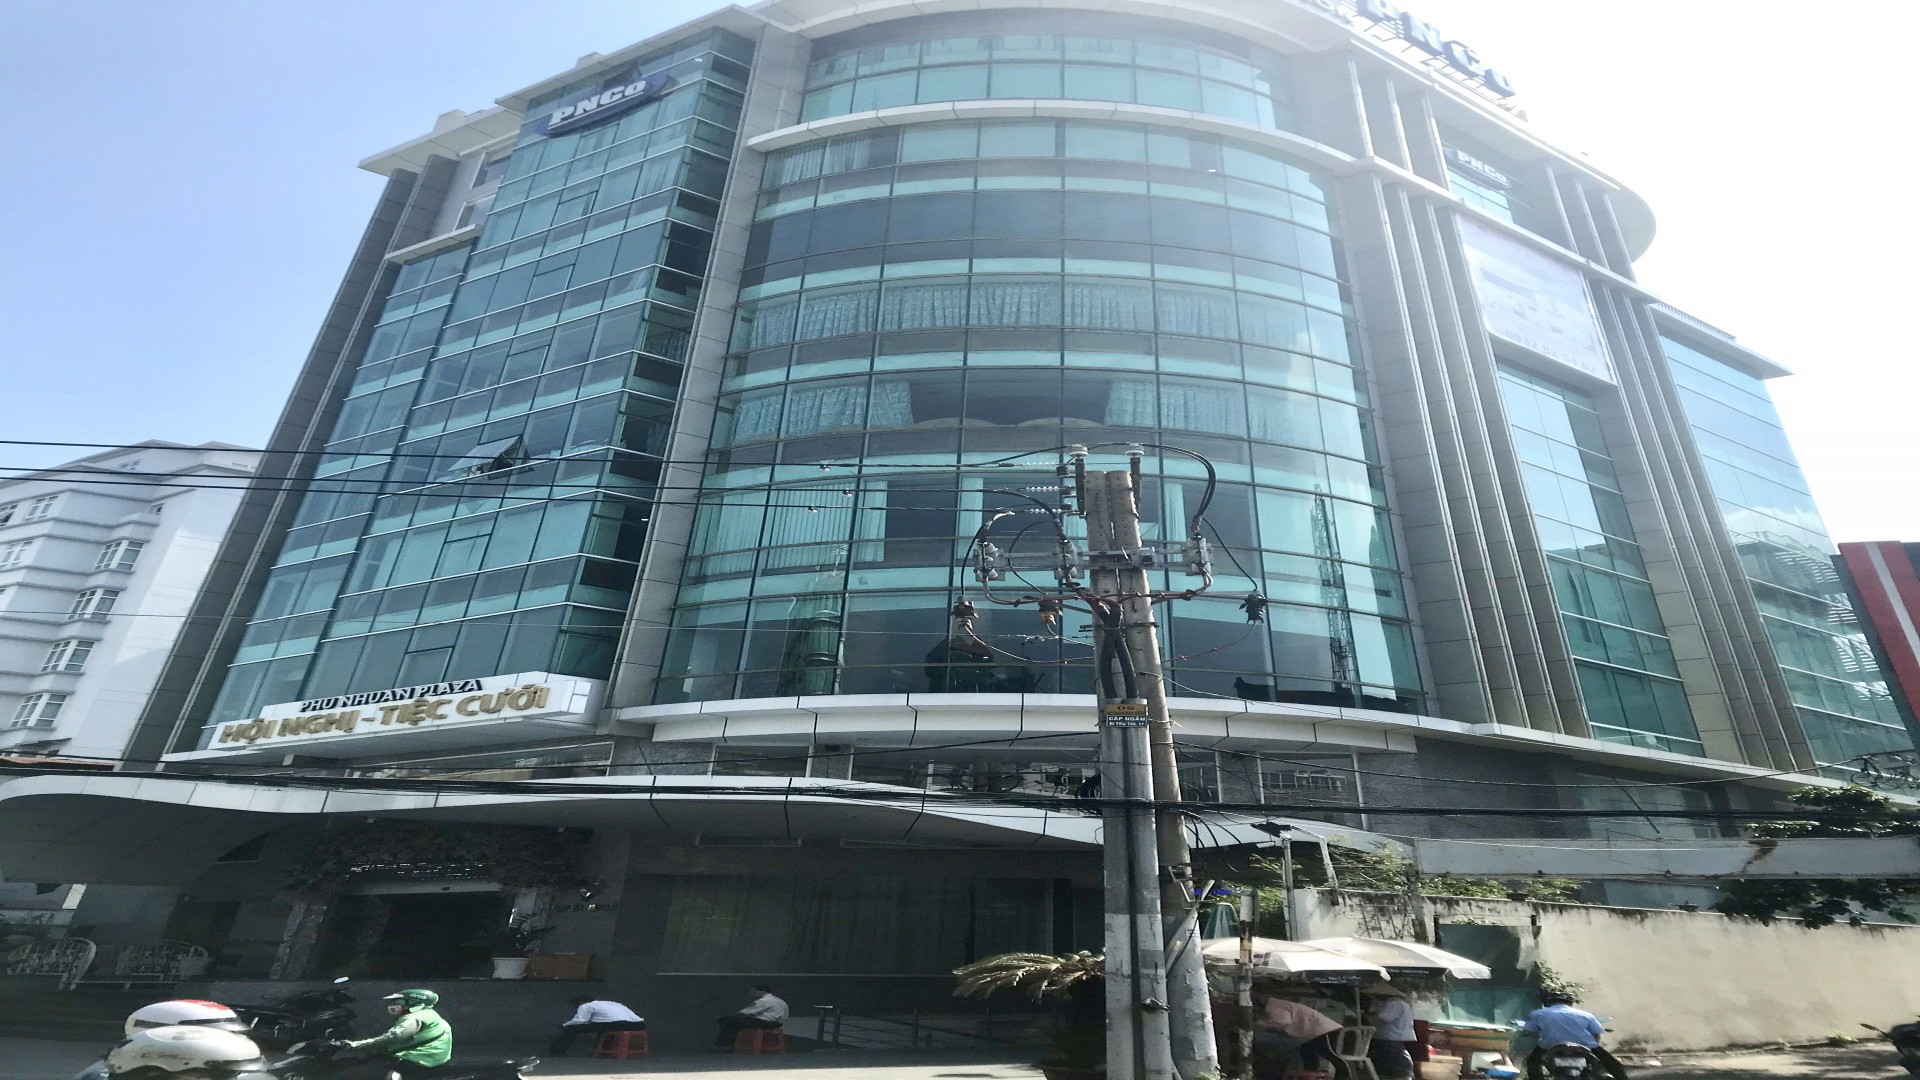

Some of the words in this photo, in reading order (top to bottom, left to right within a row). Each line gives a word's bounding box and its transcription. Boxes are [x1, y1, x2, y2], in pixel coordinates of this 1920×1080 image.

[549, 80, 647, 125] PNCO
[1457, 150, 1507, 182] PNCO
[417, 679, 484, 698] PLAZA
[218, 717, 278, 744] HỘI
[277, 709, 361, 734] NGHỊ
[379, 697, 453, 726] TIỆC
[456, 684, 550, 717] CƯỚI
